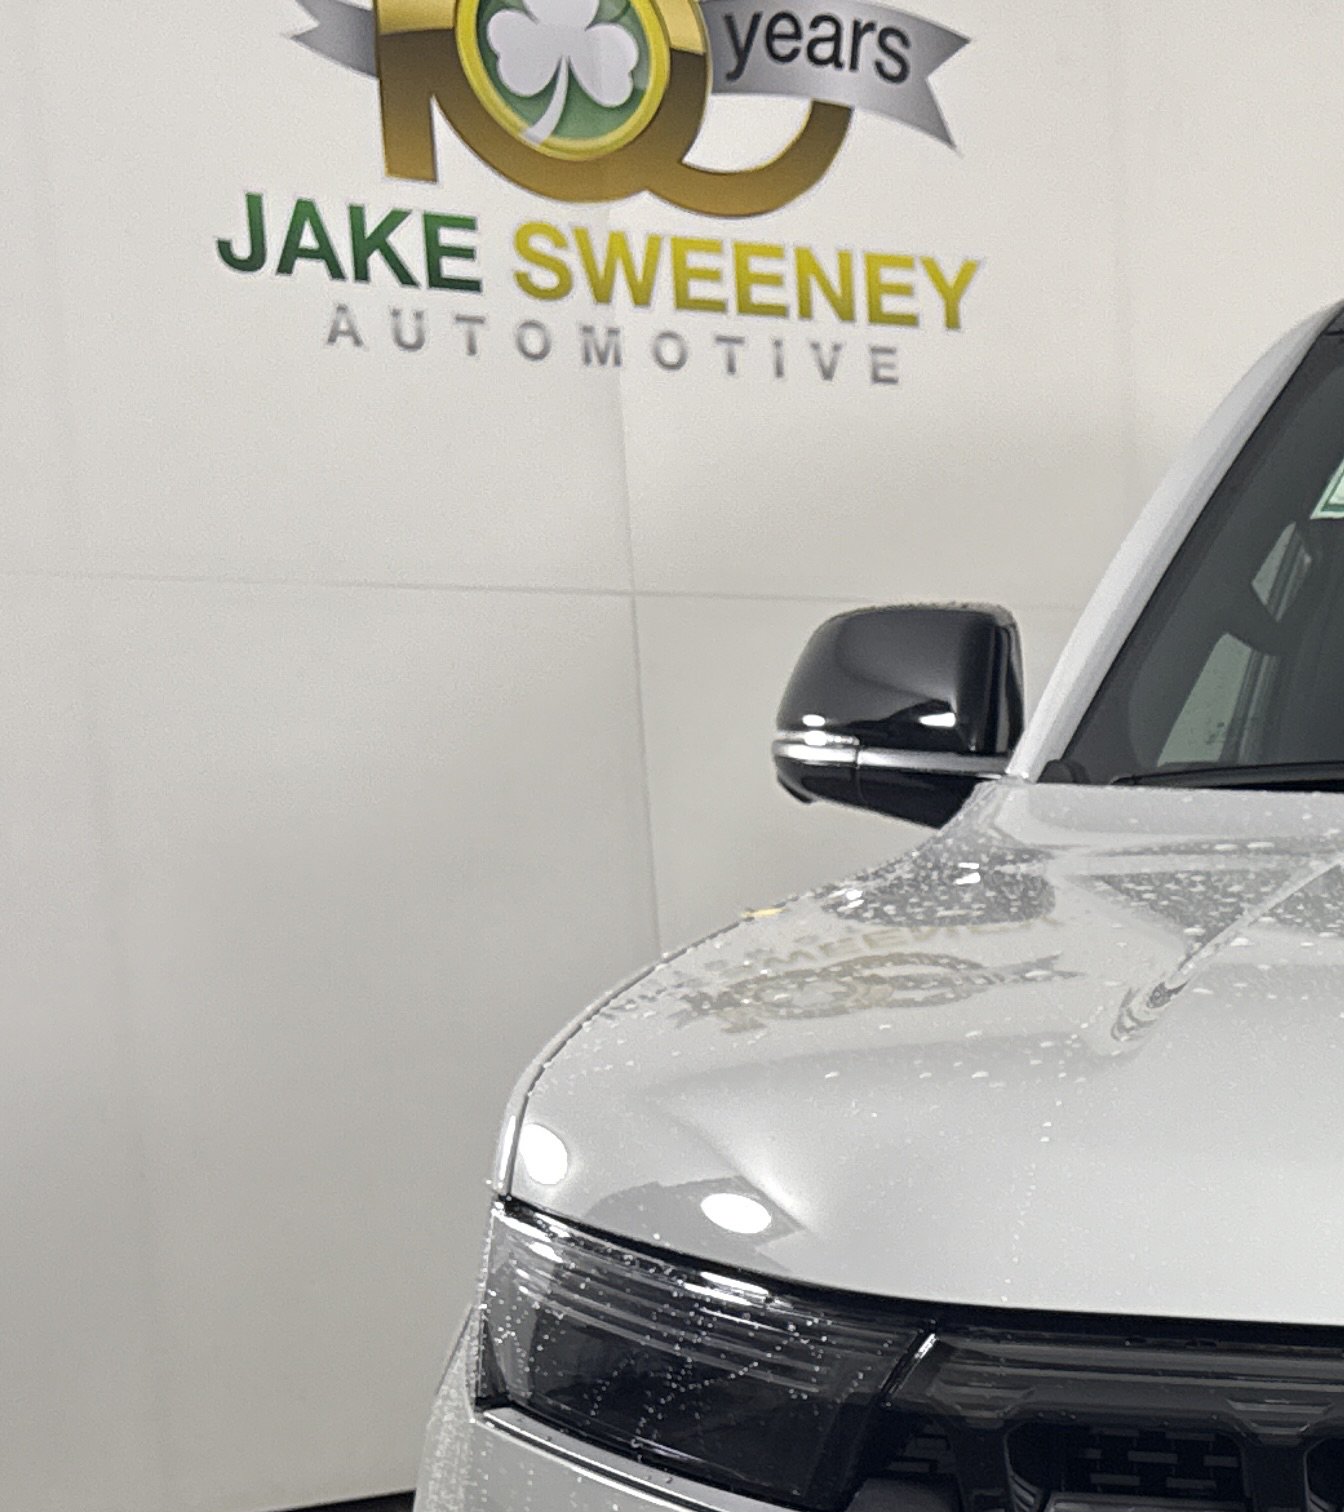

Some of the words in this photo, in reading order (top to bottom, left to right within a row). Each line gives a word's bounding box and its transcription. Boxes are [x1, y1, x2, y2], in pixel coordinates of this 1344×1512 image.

[724, 8, 912, 86] years
[215, 190, 484, 294] JAKE
[512, 219, 981, 331] SWEENEY
[325, 303, 900, 385] AUTOMOTIVE
